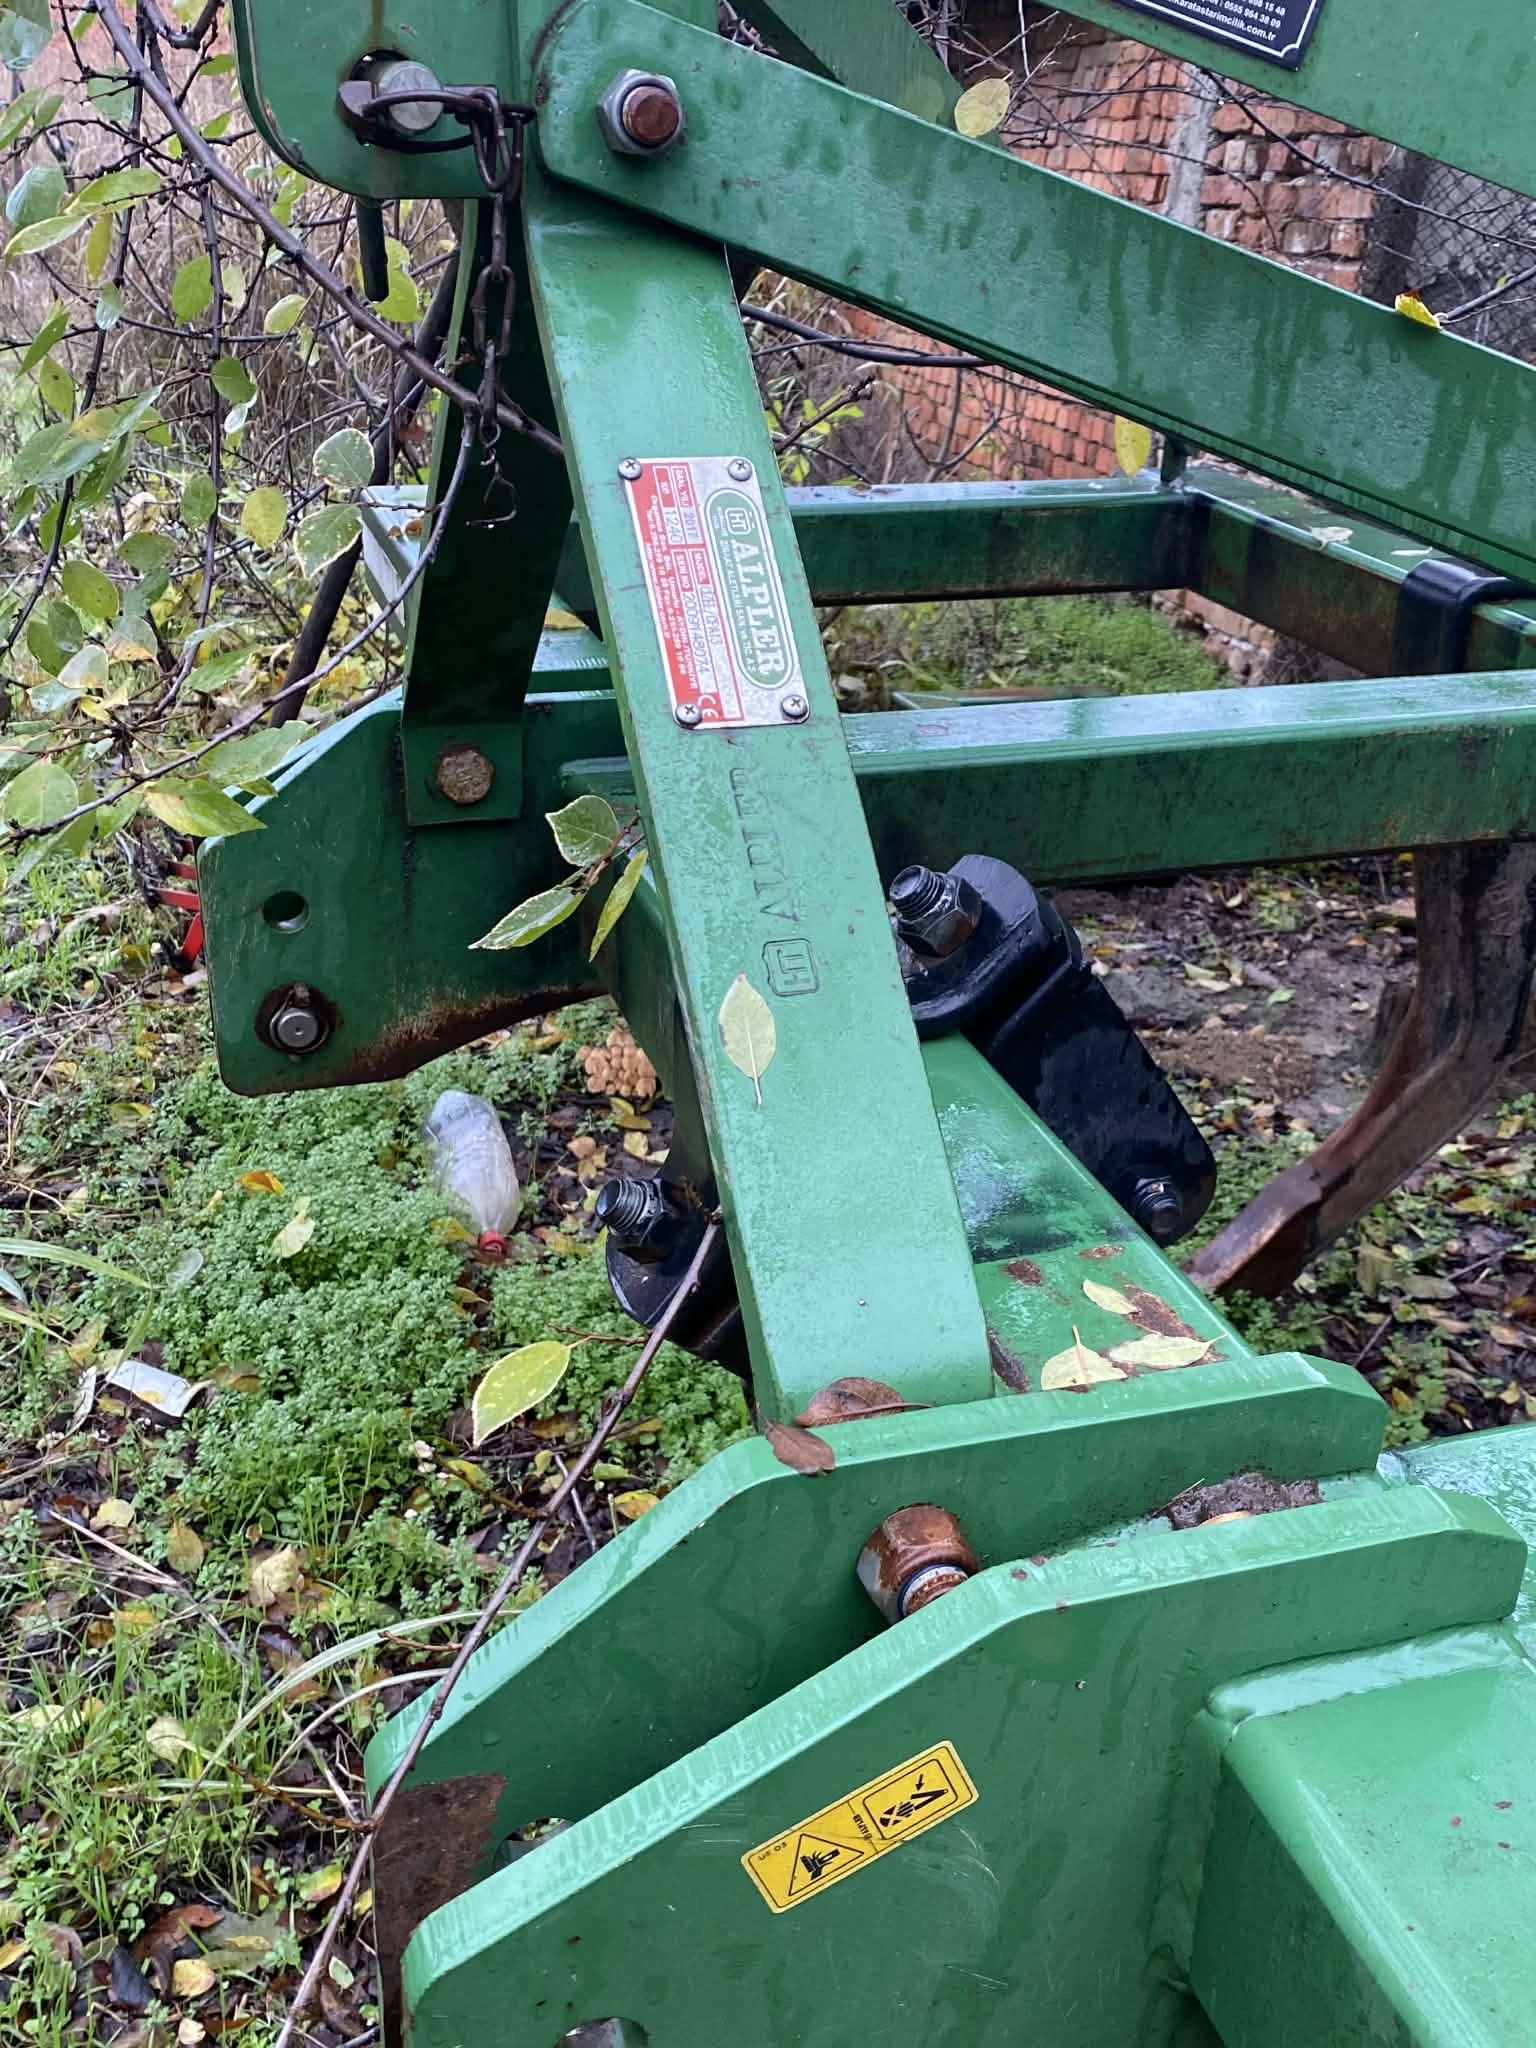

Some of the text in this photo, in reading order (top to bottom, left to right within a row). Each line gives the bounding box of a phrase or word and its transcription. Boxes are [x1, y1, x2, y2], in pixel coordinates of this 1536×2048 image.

[663, 509, 684, 543] 1240
[682, 511, 700, 539] 2017
[728, 538, 788, 674] ALPLER
